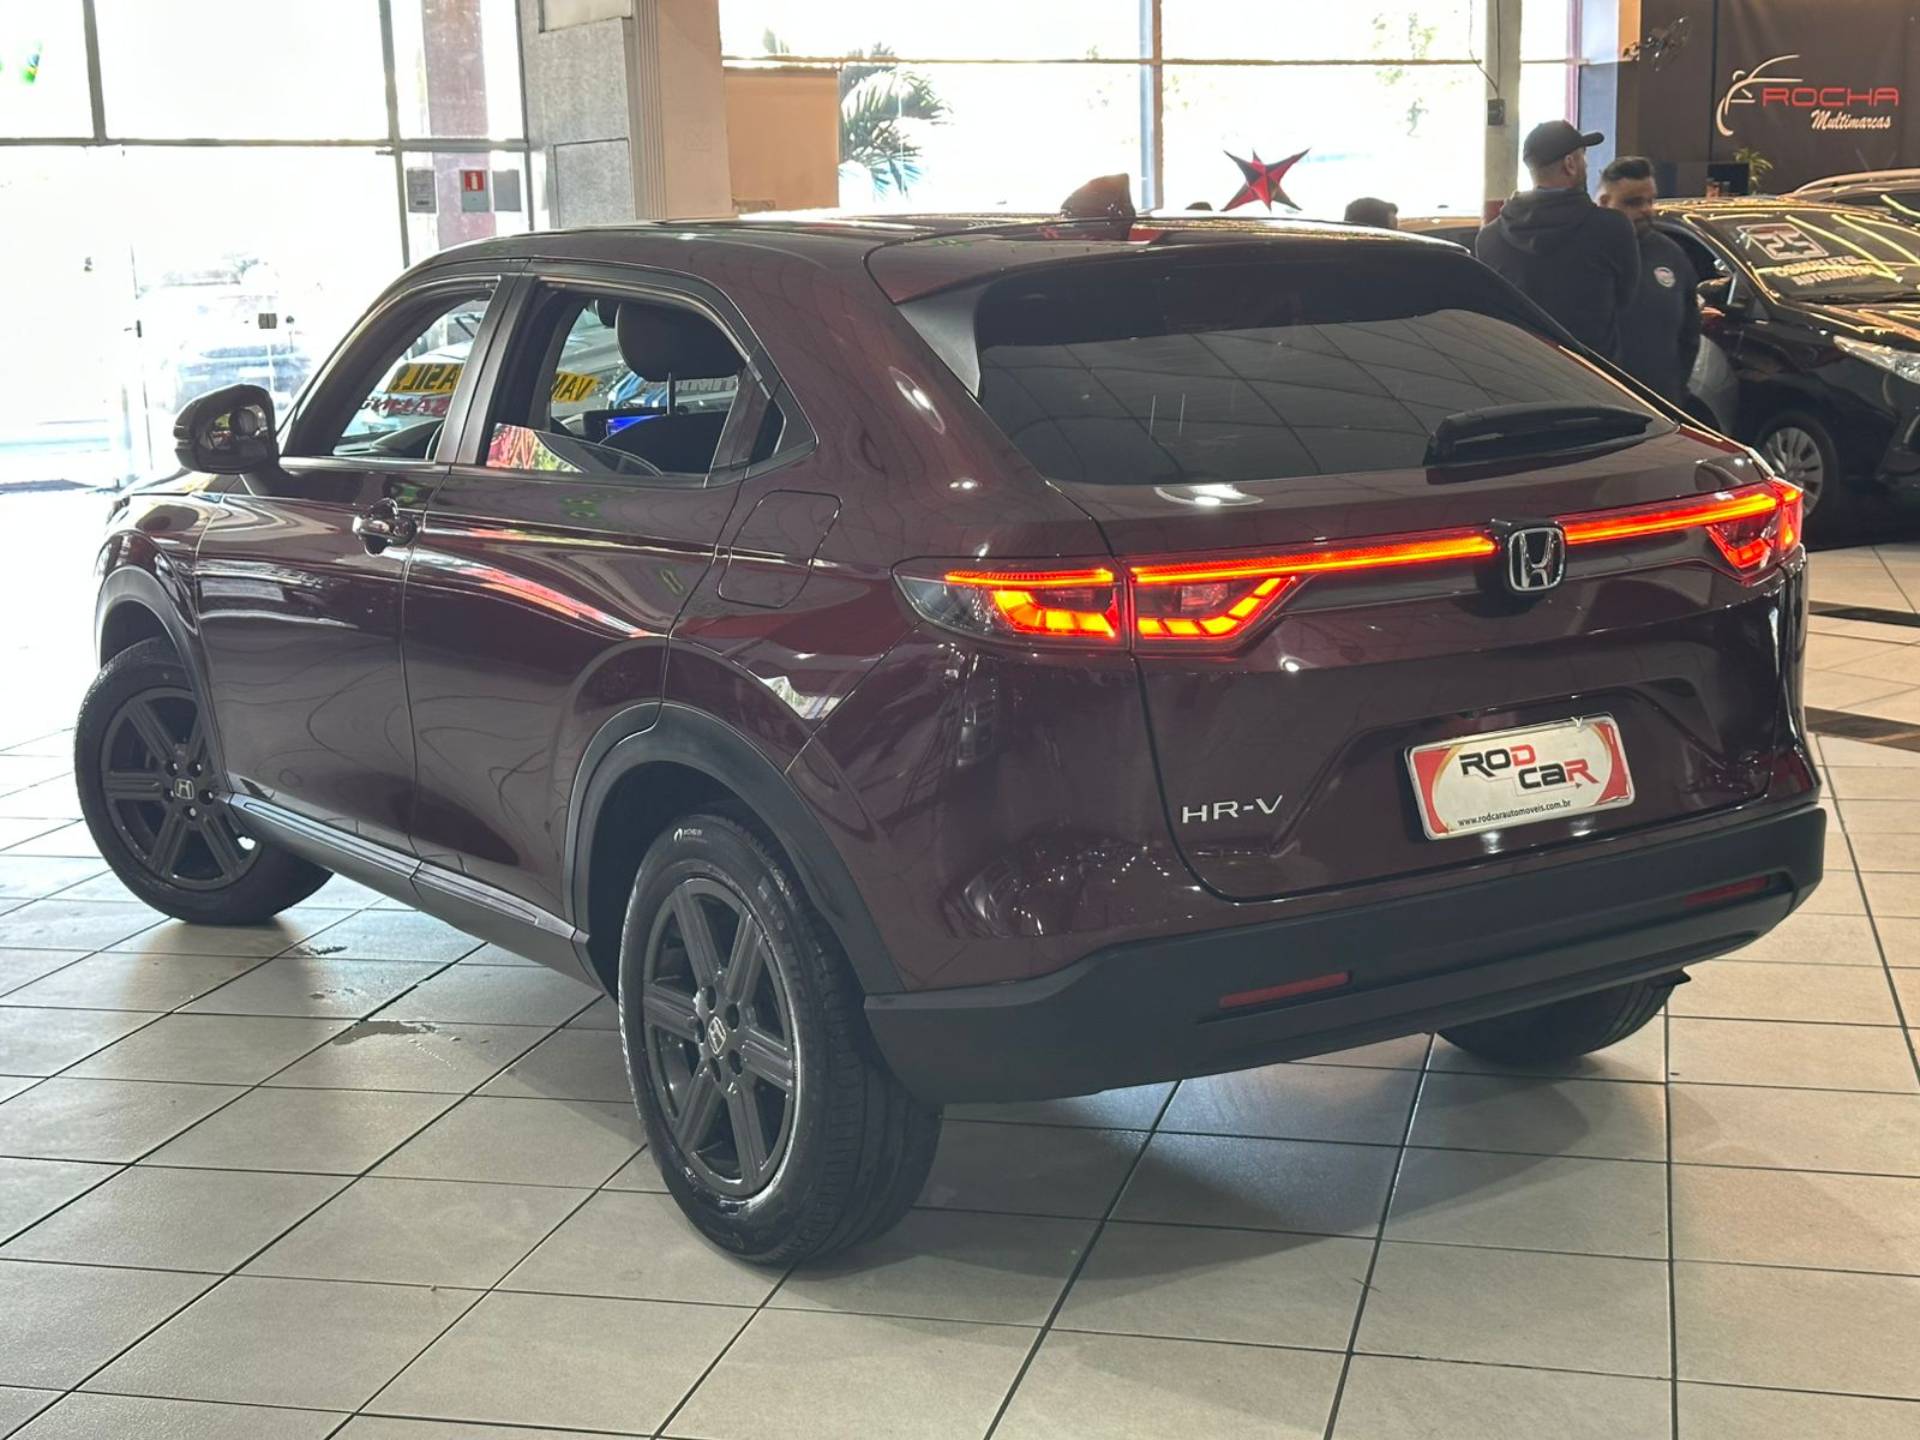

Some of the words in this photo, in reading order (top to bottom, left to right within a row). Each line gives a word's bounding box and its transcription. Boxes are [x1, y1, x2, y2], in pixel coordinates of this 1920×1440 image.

[1762, 87, 1899, 107] ROCHA
[1810, 109, 1891, 130] Multimarcas
[1458, 744, 1536, 778] ROD
[1182, 794, 1283, 824] HR-V
[1457, 799, 1571, 826] www.rodcarautomoveis.com.br
